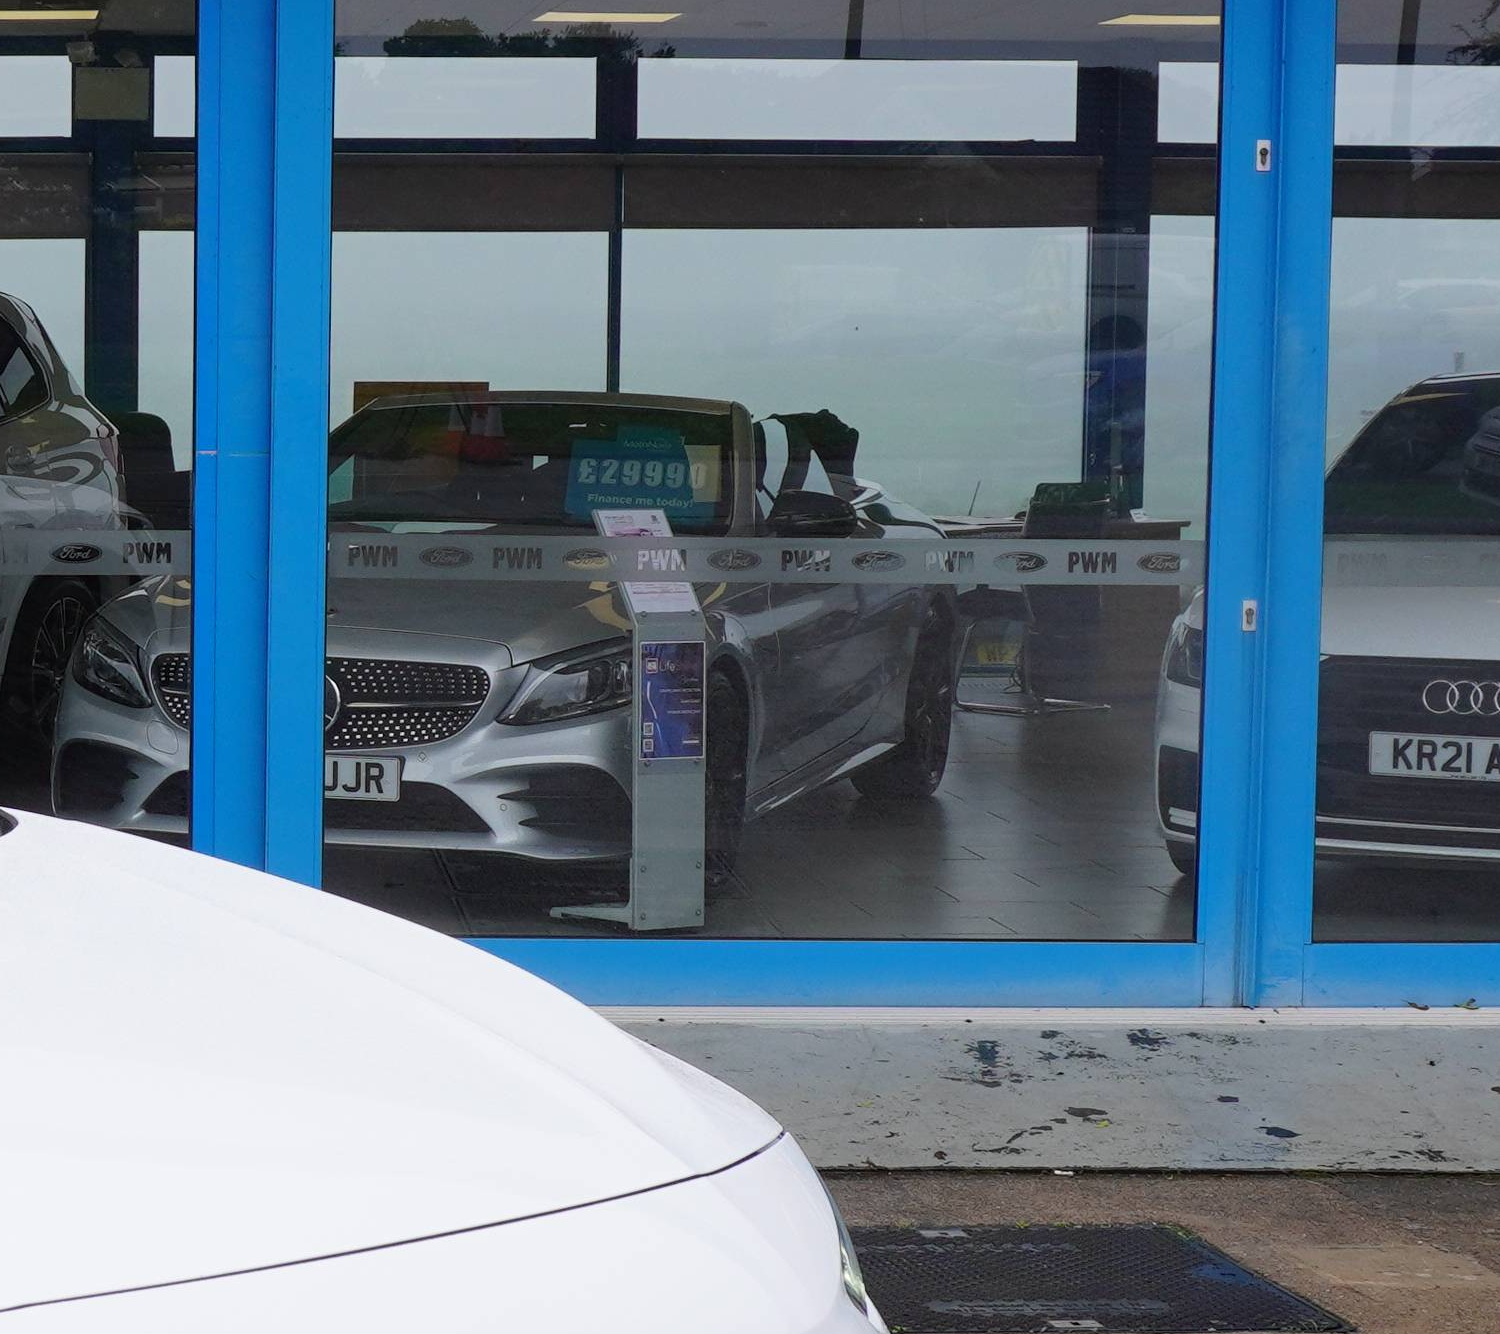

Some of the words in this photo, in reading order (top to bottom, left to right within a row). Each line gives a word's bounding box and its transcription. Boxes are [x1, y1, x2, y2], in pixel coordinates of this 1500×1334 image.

[587, 493, 632, 505] Finance
[635, 496, 653, 505] me
[657, 498, 694, 508] today!
[123, 542, 172, 564] PWM
[348, 545, 398, 567] PWM
[492, 547, 543, 569] PWM
[637, 549, 688, 572] PWM
[781, 550, 832, 572] PWM
[1068, 551, 1117, 574] PWM
[1392, 737, 1473, 773] KR21
